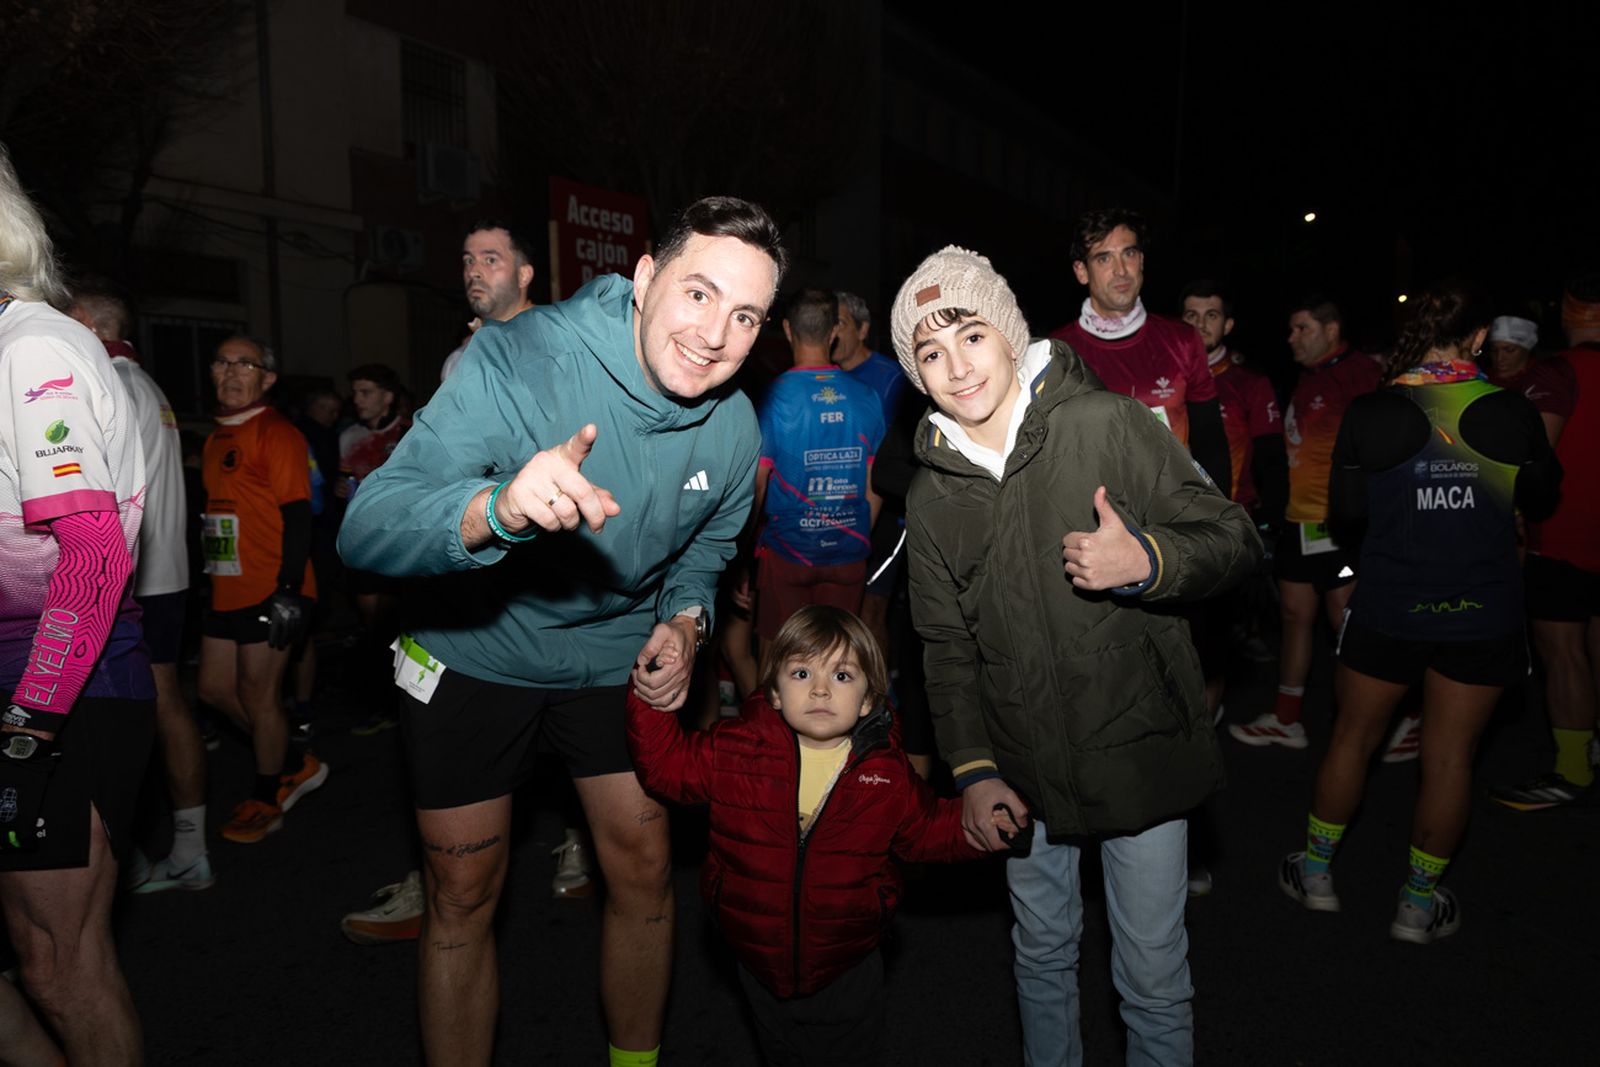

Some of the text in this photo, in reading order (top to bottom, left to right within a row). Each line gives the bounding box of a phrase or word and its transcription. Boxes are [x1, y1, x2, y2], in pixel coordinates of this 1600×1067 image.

[566, 194, 635, 236] Acceso
[576, 232, 629, 268] cajón
[820, 411, 845, 424] FER
[1416, 484, 1476, 511] MACA
[33, 608, 79, 676] YELMO
[24, 682, 58, 706] EL
